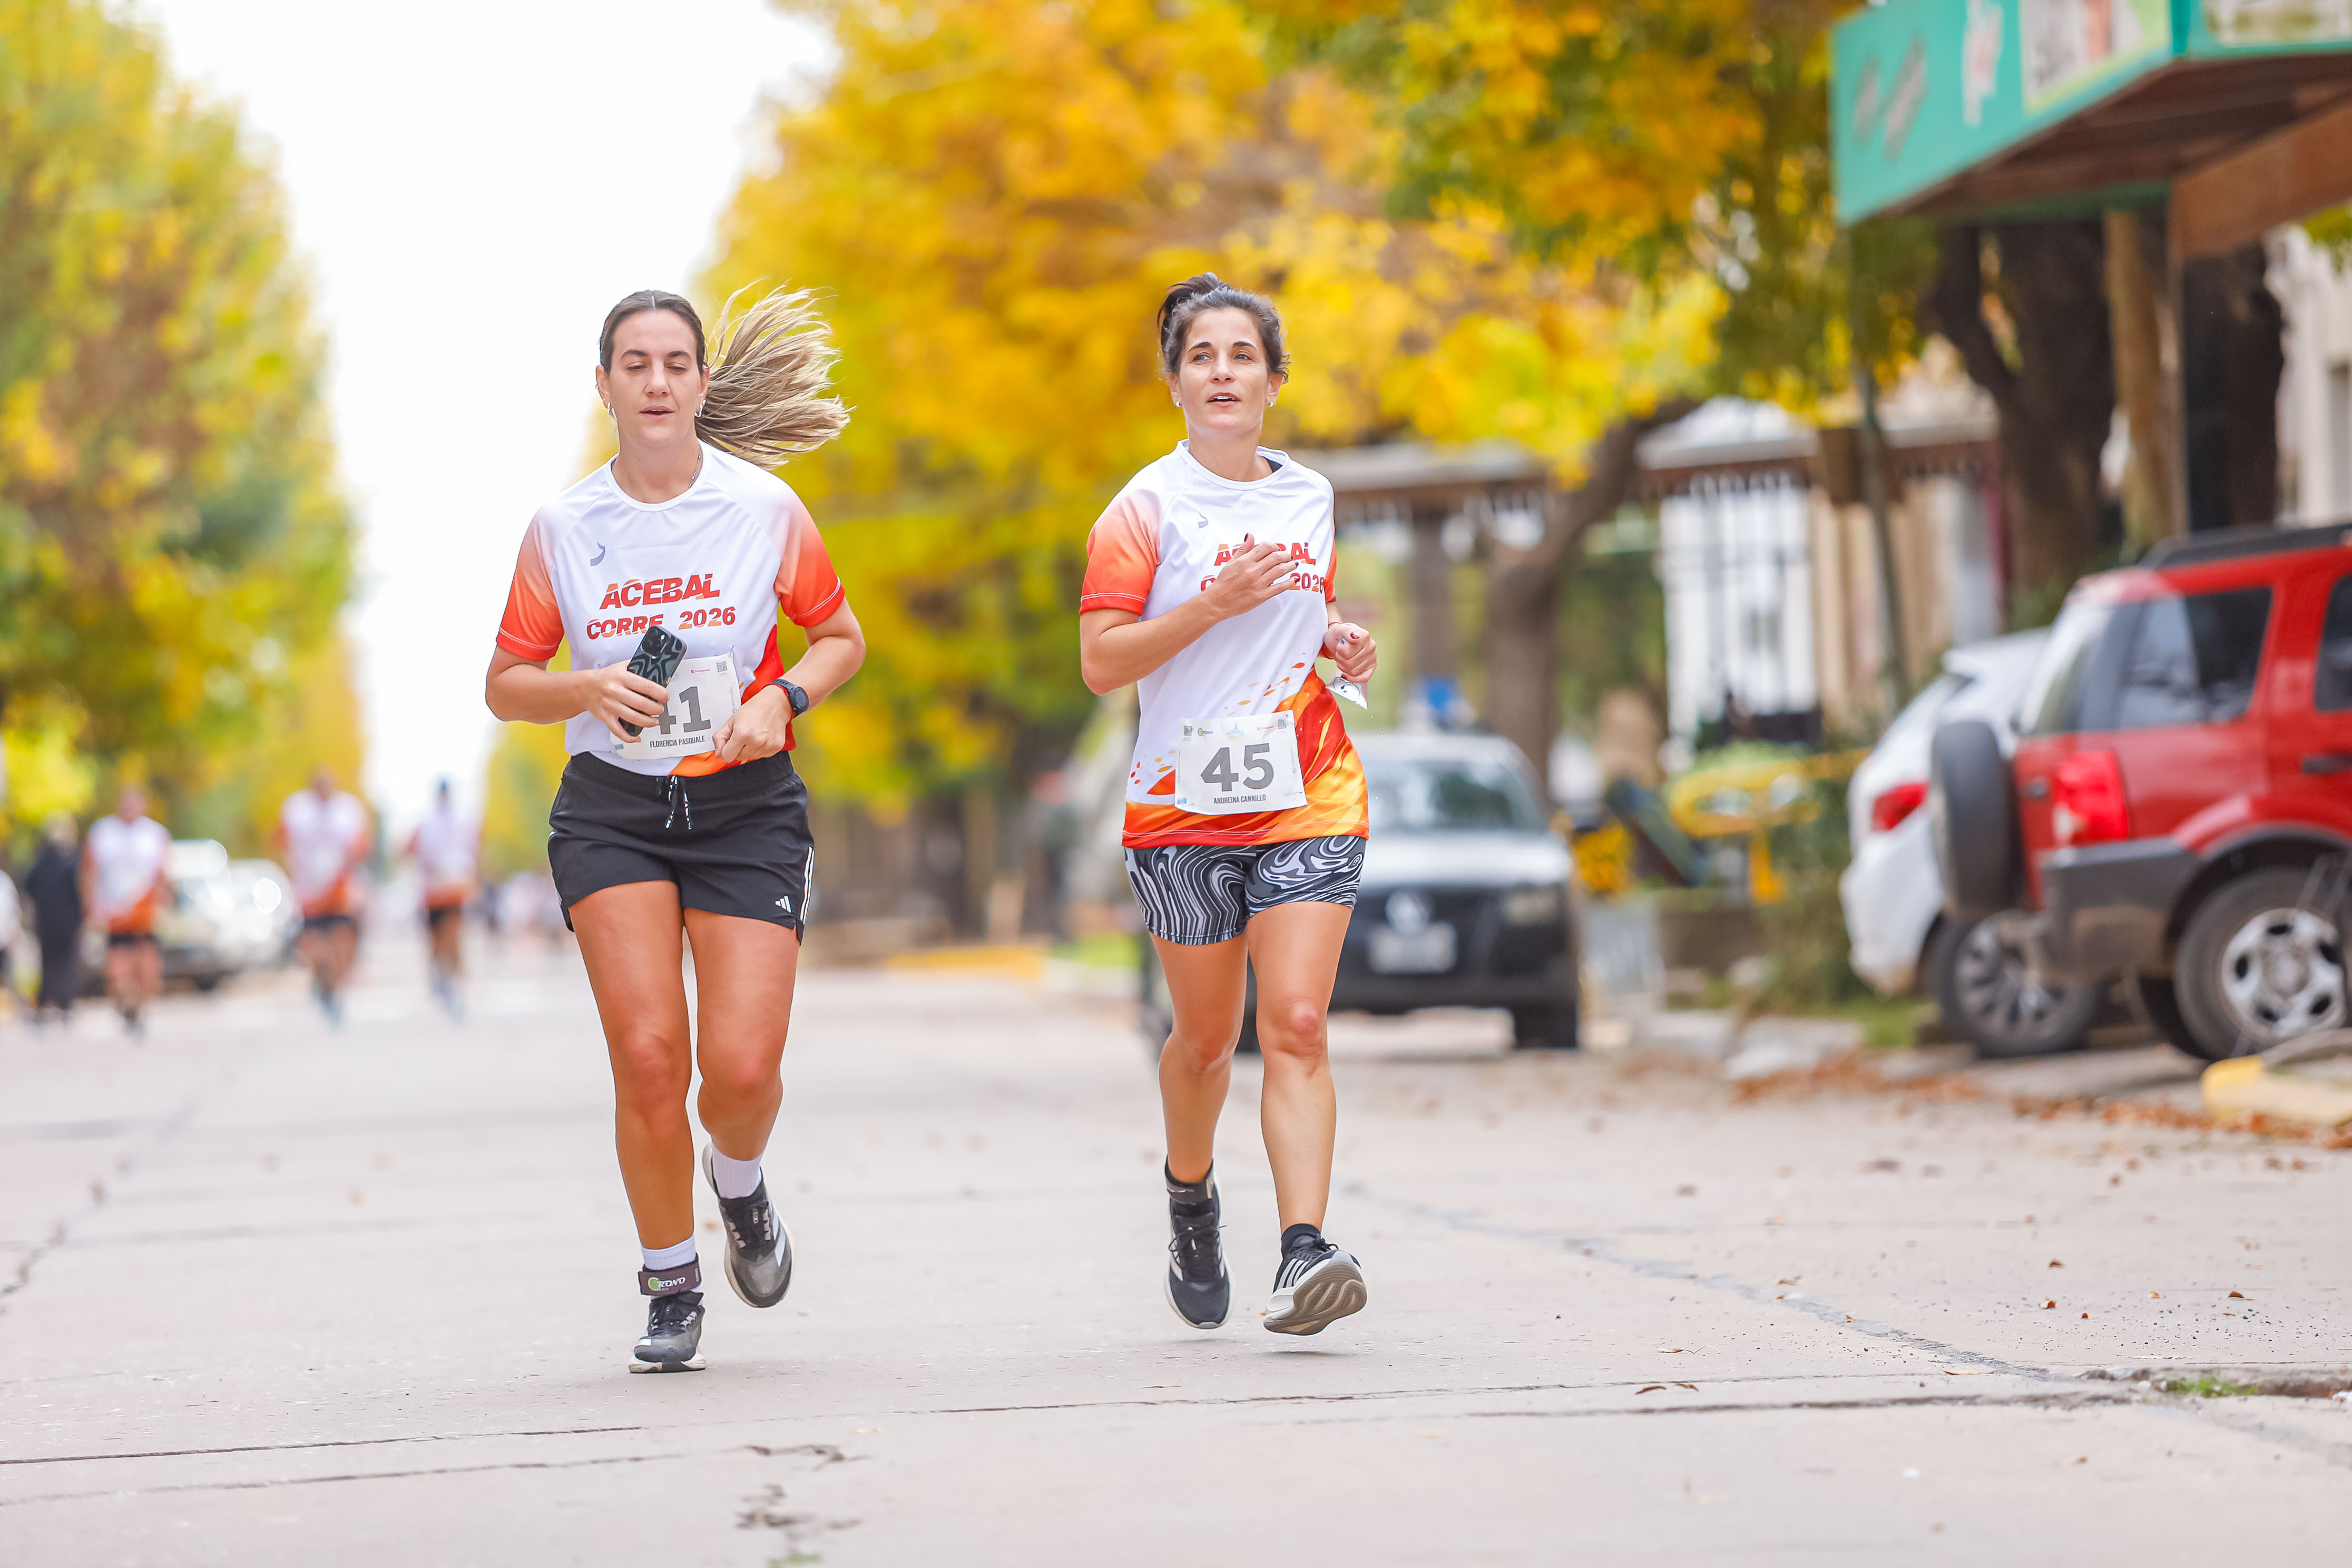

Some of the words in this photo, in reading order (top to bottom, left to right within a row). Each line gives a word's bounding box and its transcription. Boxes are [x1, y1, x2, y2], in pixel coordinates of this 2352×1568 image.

[1214, 542, 1316, 566] AAL
[599, 573, 720, 610] ACEBAL
[678, 606, 736, 630] 2026
[650, 739, 678, 748] FLORENCIA
[679, 735, 705, 746] PASQUALE
[1200, 742, 1274, 792] 45
[648, 1277, 686, 1291] CRONO
